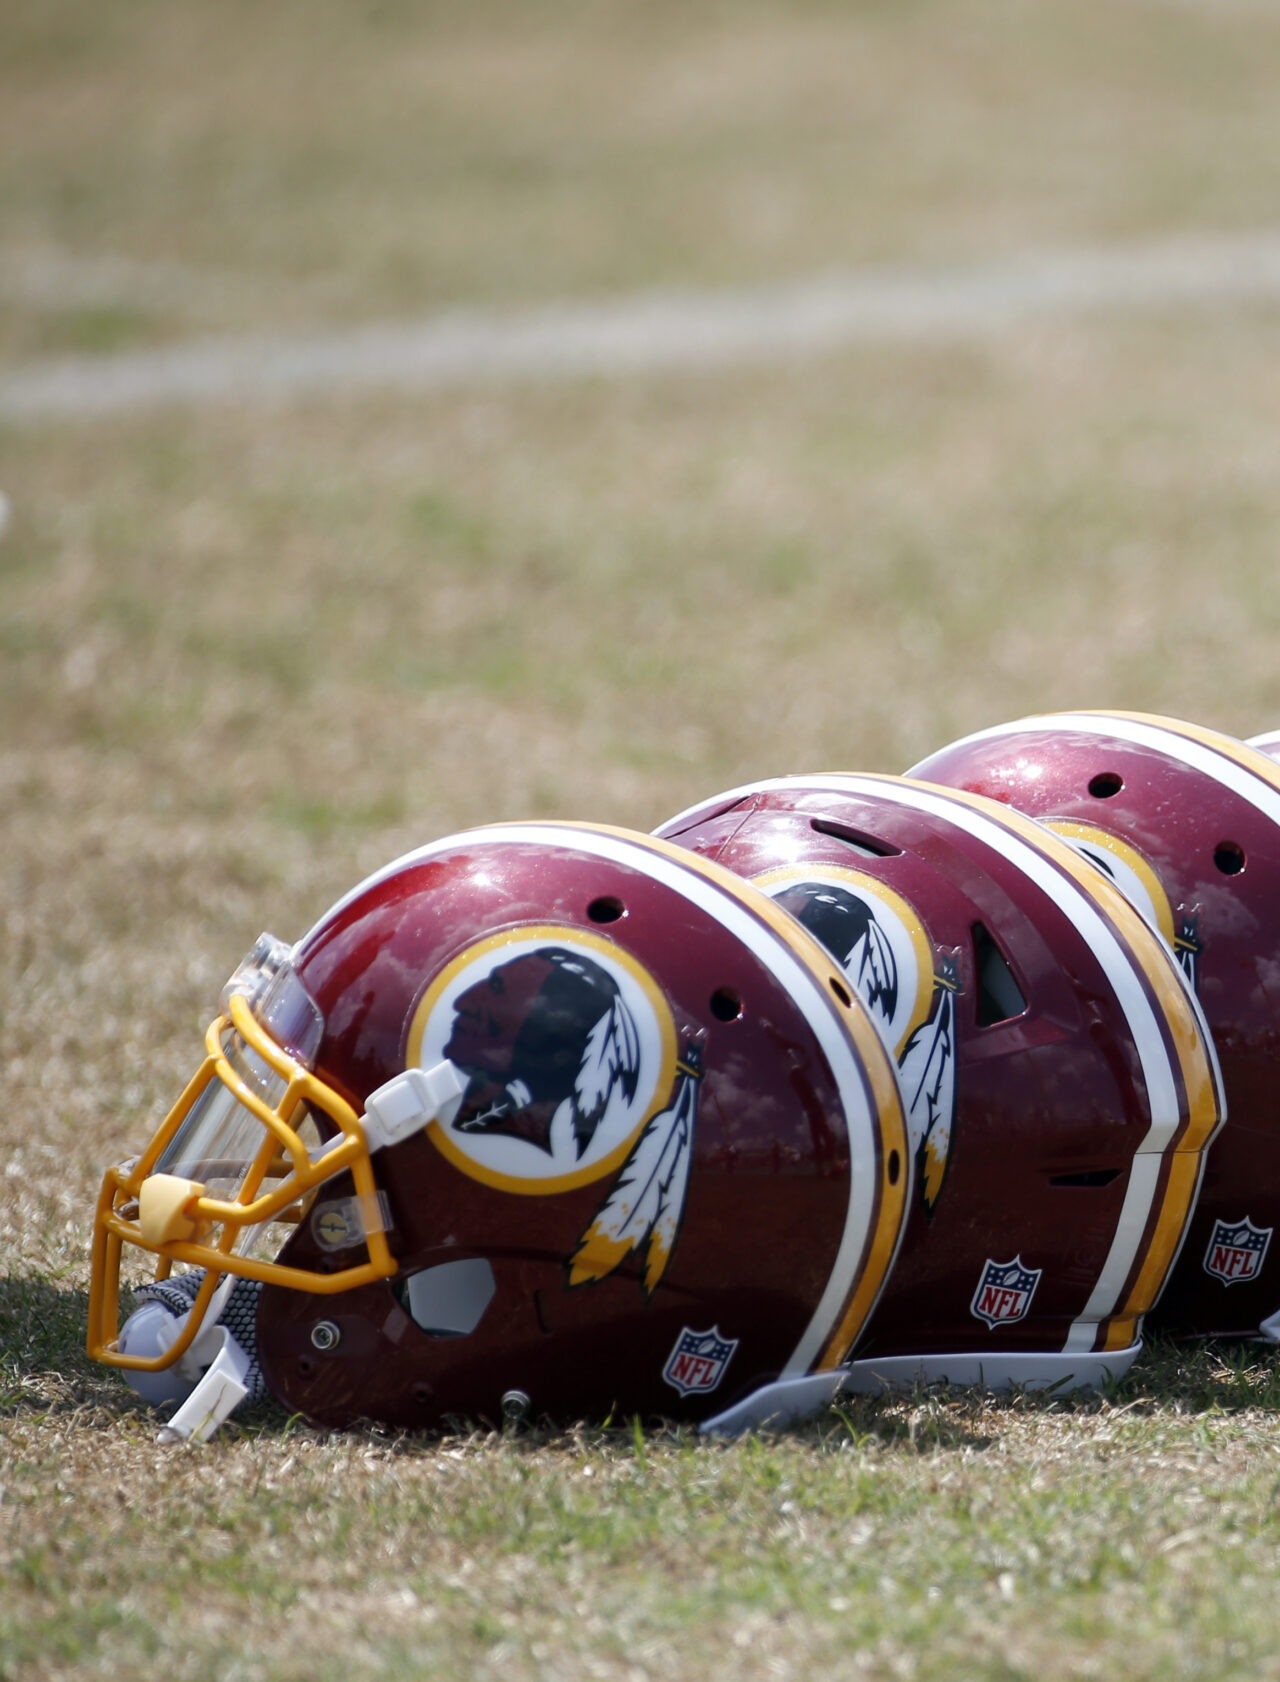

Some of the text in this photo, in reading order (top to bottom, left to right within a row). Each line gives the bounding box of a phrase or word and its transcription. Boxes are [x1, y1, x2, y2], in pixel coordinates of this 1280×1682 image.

[1210, 1245, 1253, 1277] NFL
[979, 1286, 1023, 1319] NFL
[671, 1354, 715, 1386] NFL
